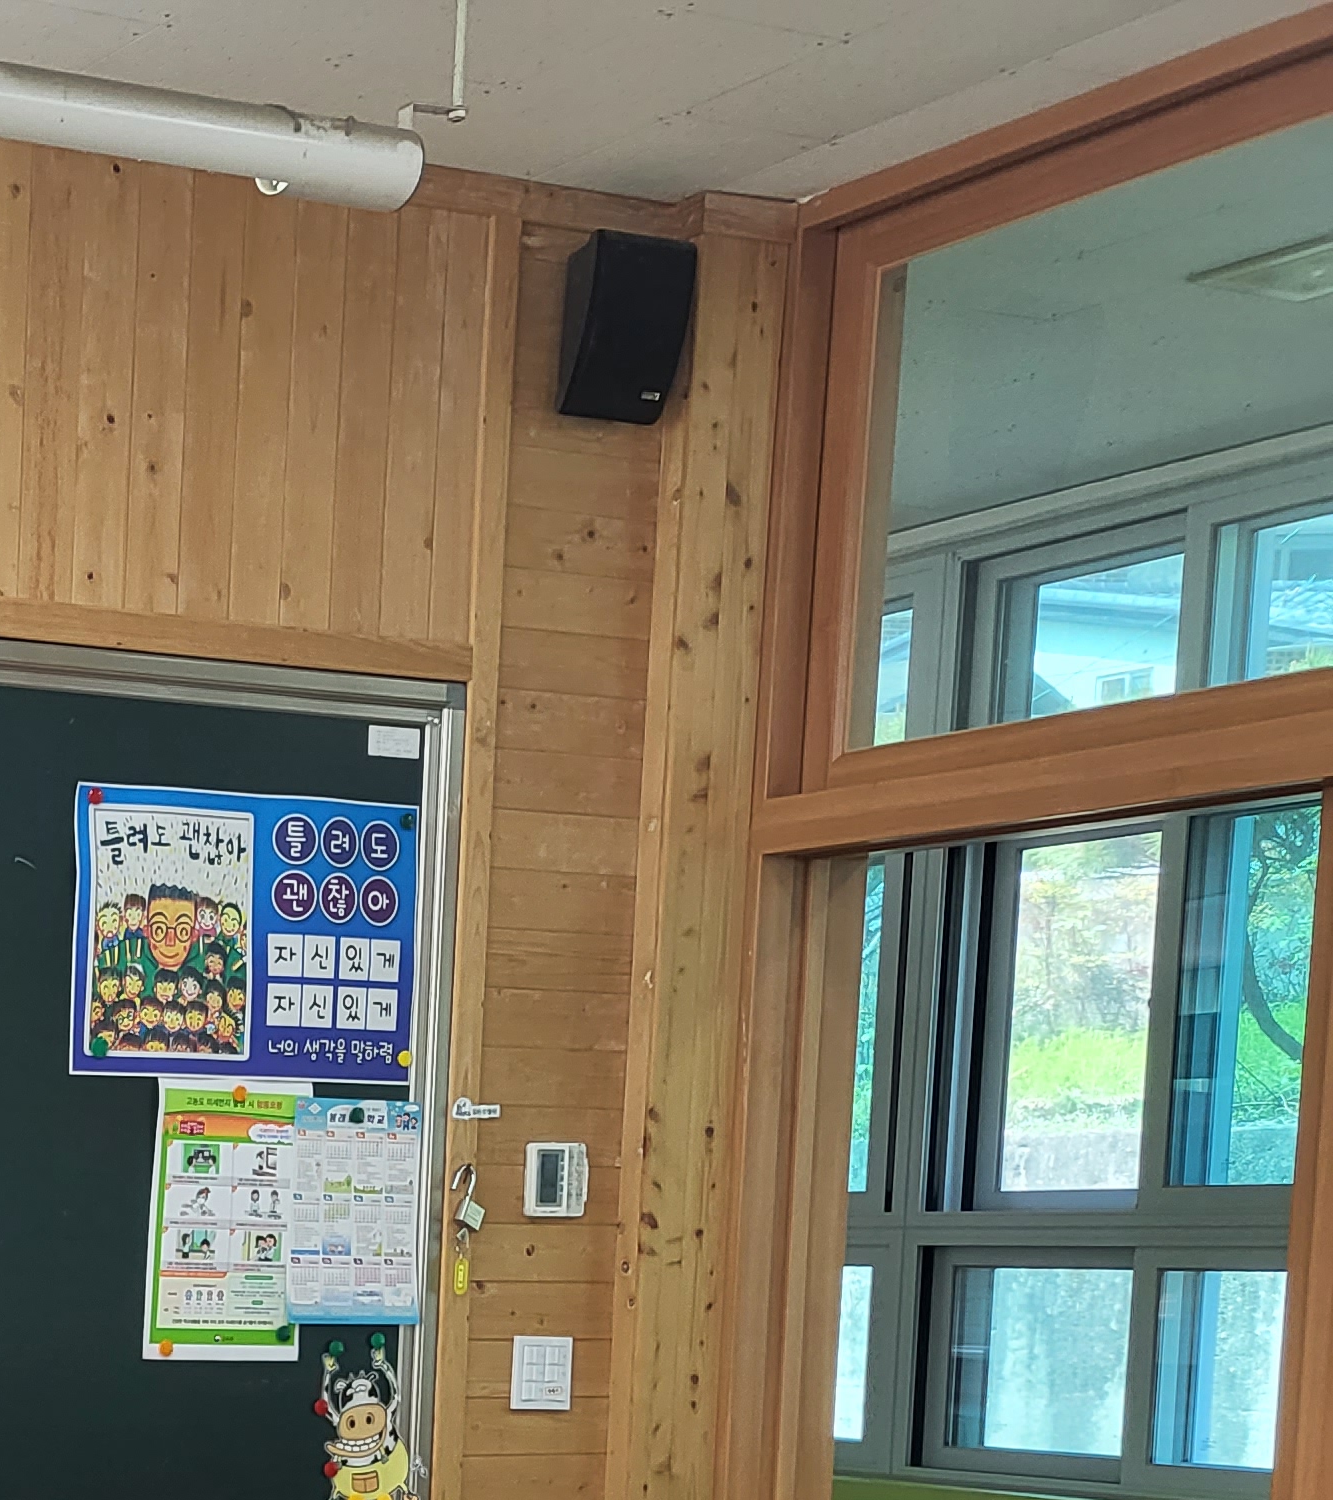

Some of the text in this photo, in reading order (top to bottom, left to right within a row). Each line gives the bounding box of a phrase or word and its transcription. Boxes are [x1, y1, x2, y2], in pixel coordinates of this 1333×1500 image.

[100, 820, 247, 867] 틀려도 괜찮아
[284, 820, 388, 860] 틀려도
[282, 877, 390, 917] 괜찮아
[268, 1039, 393, 1063] 너의 생각을 말하렴
